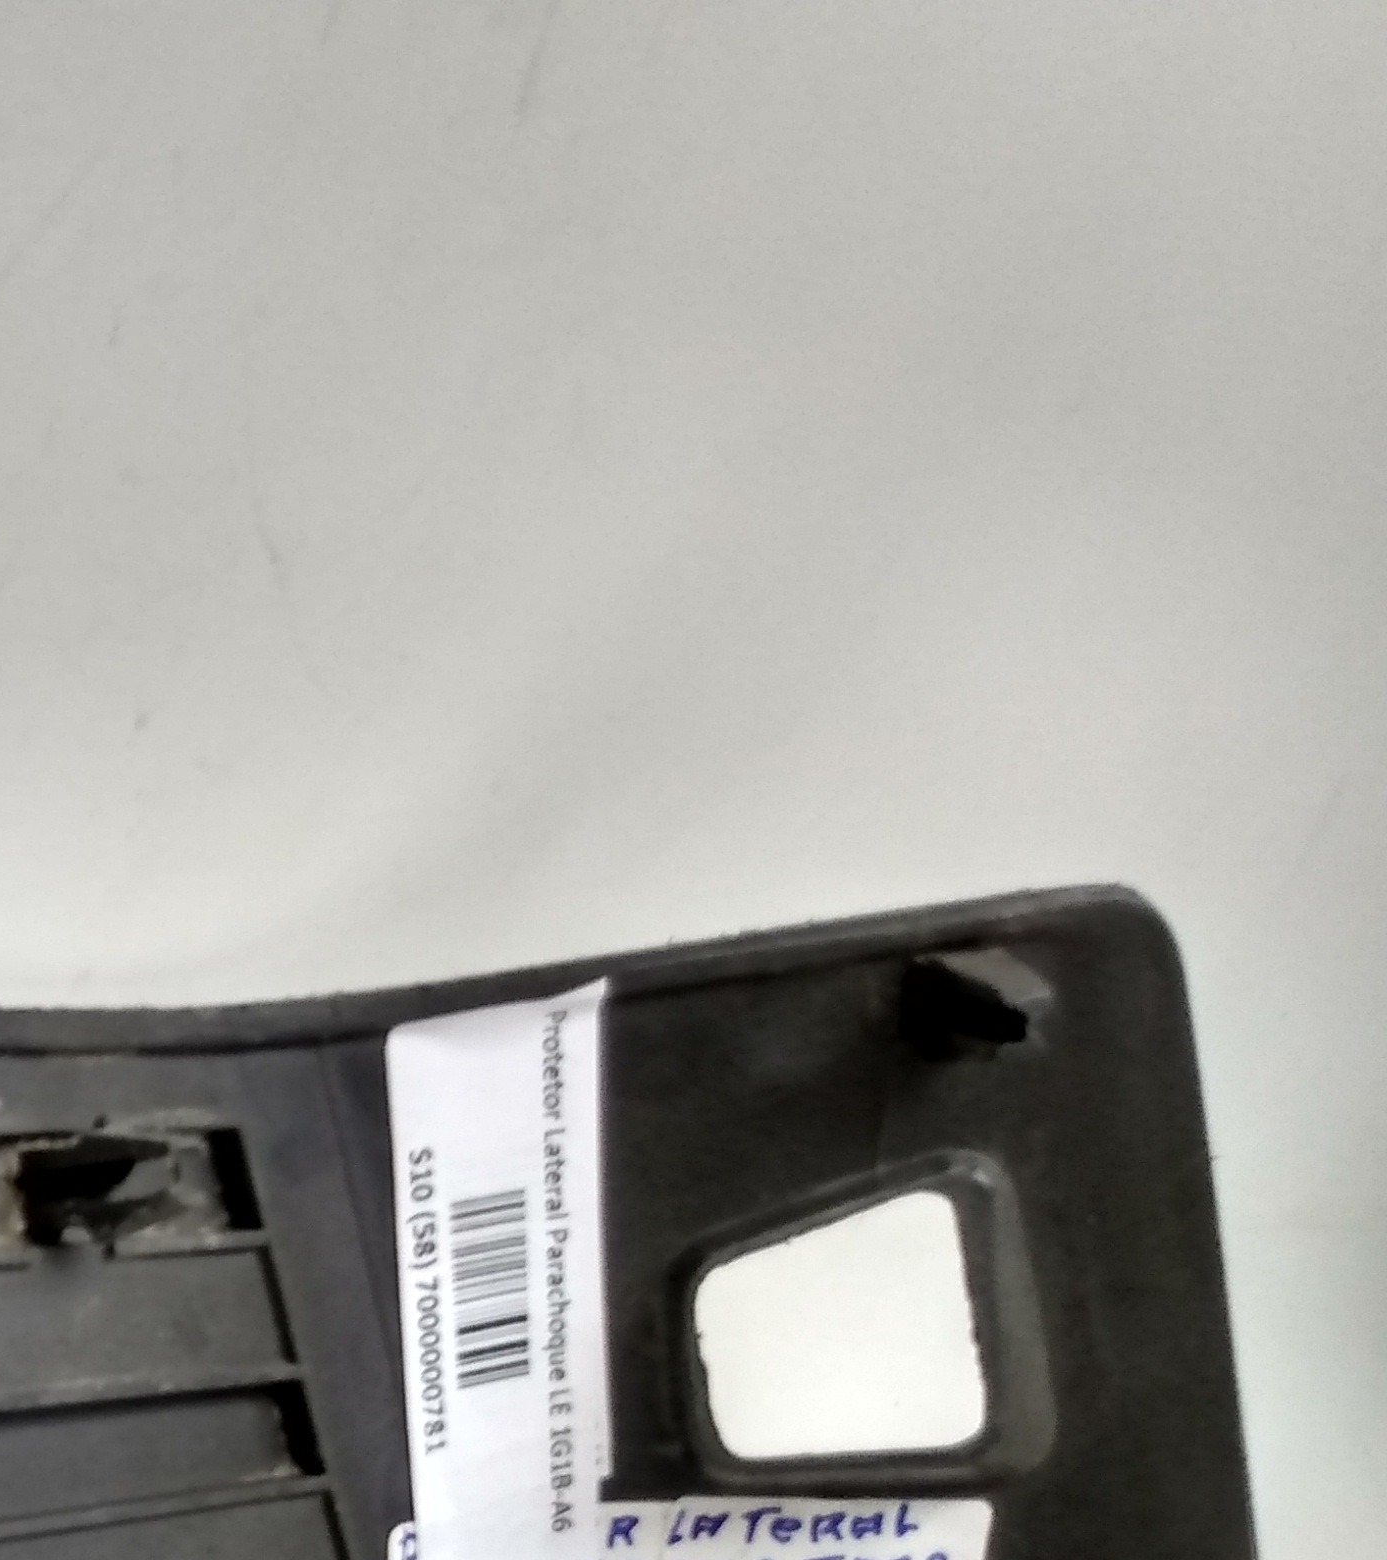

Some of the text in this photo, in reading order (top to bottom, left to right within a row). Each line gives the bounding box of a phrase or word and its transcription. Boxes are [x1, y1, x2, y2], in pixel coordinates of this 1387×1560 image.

[542, 1010, 567, 1121] Protetor
[409, 1147, 435, 1203] S10
[543, 1128, 569, 1221] Lateral
[542, 1227, 572, 1382] Parachoque
[416, 1275, 447, 1456] 7000000781
[548, 1387, 572, 1417] LE
